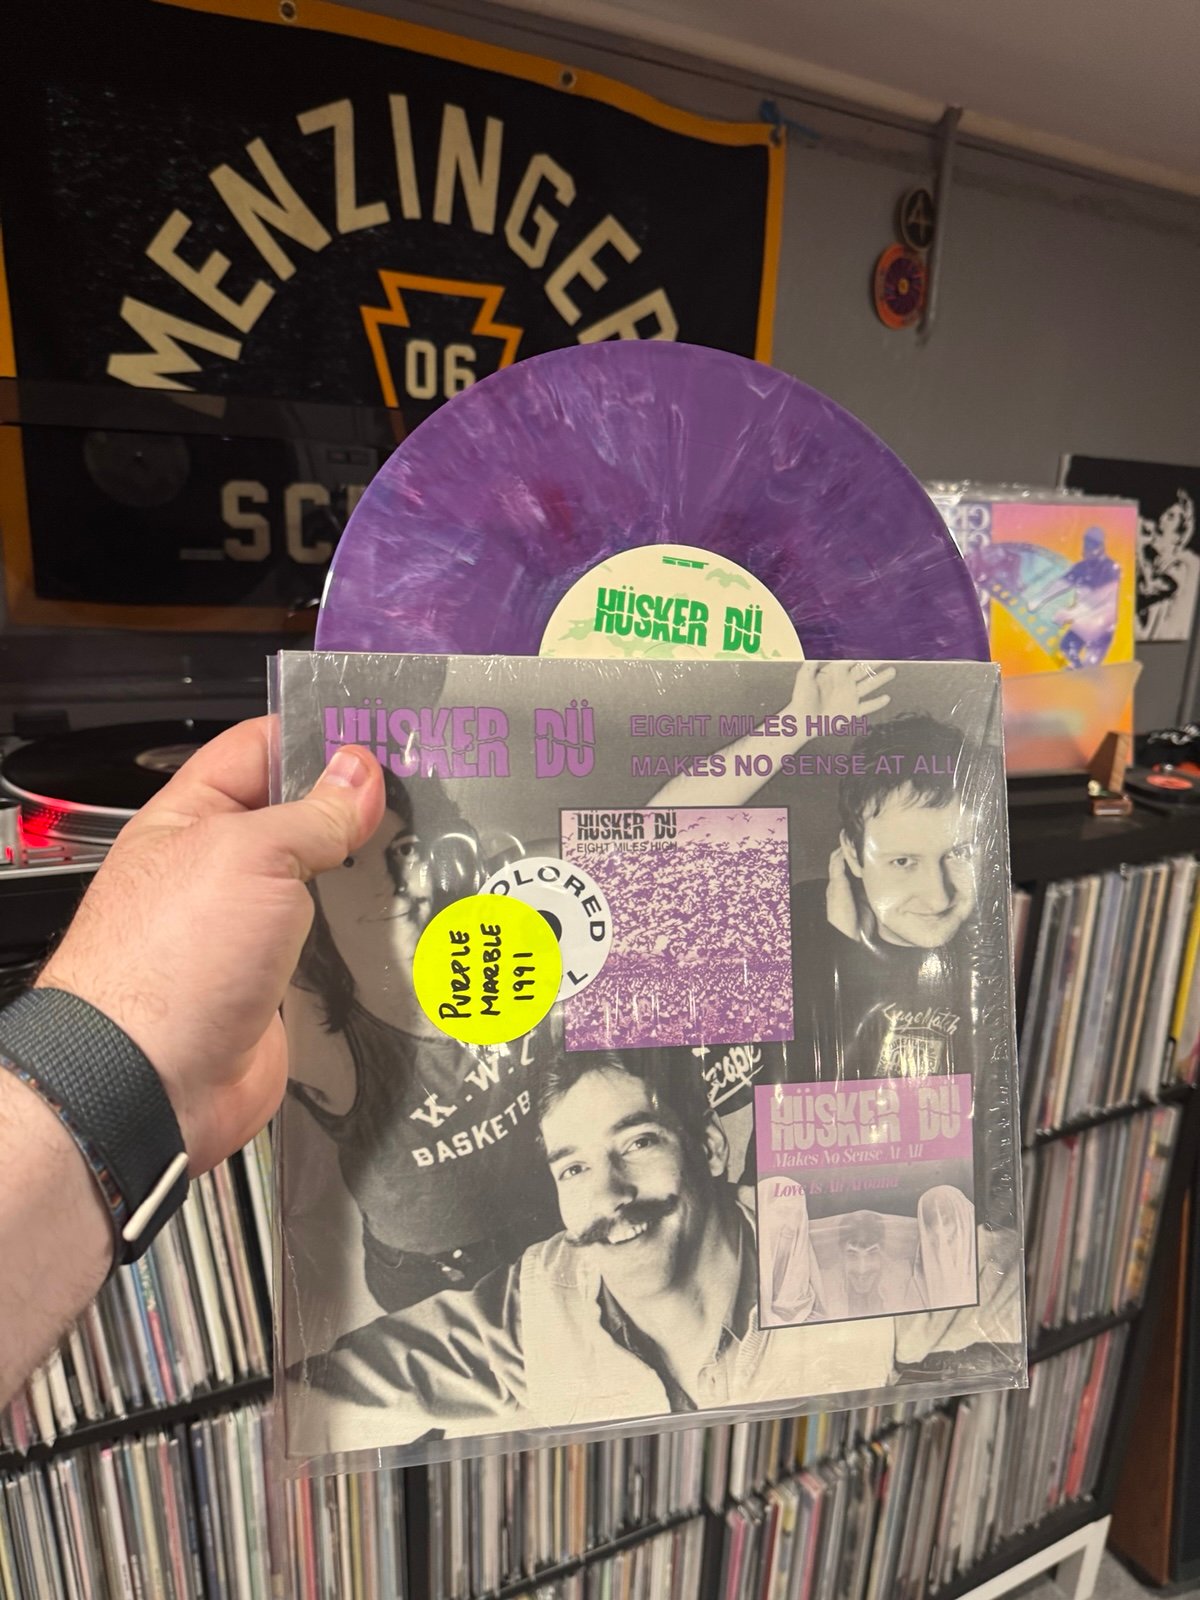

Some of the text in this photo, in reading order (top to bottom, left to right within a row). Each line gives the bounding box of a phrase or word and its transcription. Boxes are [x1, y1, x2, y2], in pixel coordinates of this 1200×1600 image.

[406, 339, 476, 400] 06
[220, 479, 368, 565] SC
[594, 585, 763, 653] HÜSKER DÜ
[534, 698, 597, 779] DÜ
[629, 714, 868, 738] EIGHT MILES HIGH
[631, 754, 957, 777] MAKES NO SENSE AT ALL
[576, 809, 678, 841] HÜSKER DÜ
[576, 841, 678, 854] EIGHT MILES HIGH
[490, 866, 606, 942] OLORED
[438, 930, 472, 1020] PURPLE
[480, 923, 503, 1017] MARBLE
[512, 952, 536, 1001] 1991
[770, 1080, 961, 1152] HÜSKER DÜ
[774, 1150, 819, 1168] Makes
[820, 1150, 840, 1165] No
[843, 1148, 883, 1164] Sense
[773, 1182, 805, 1199] Love
